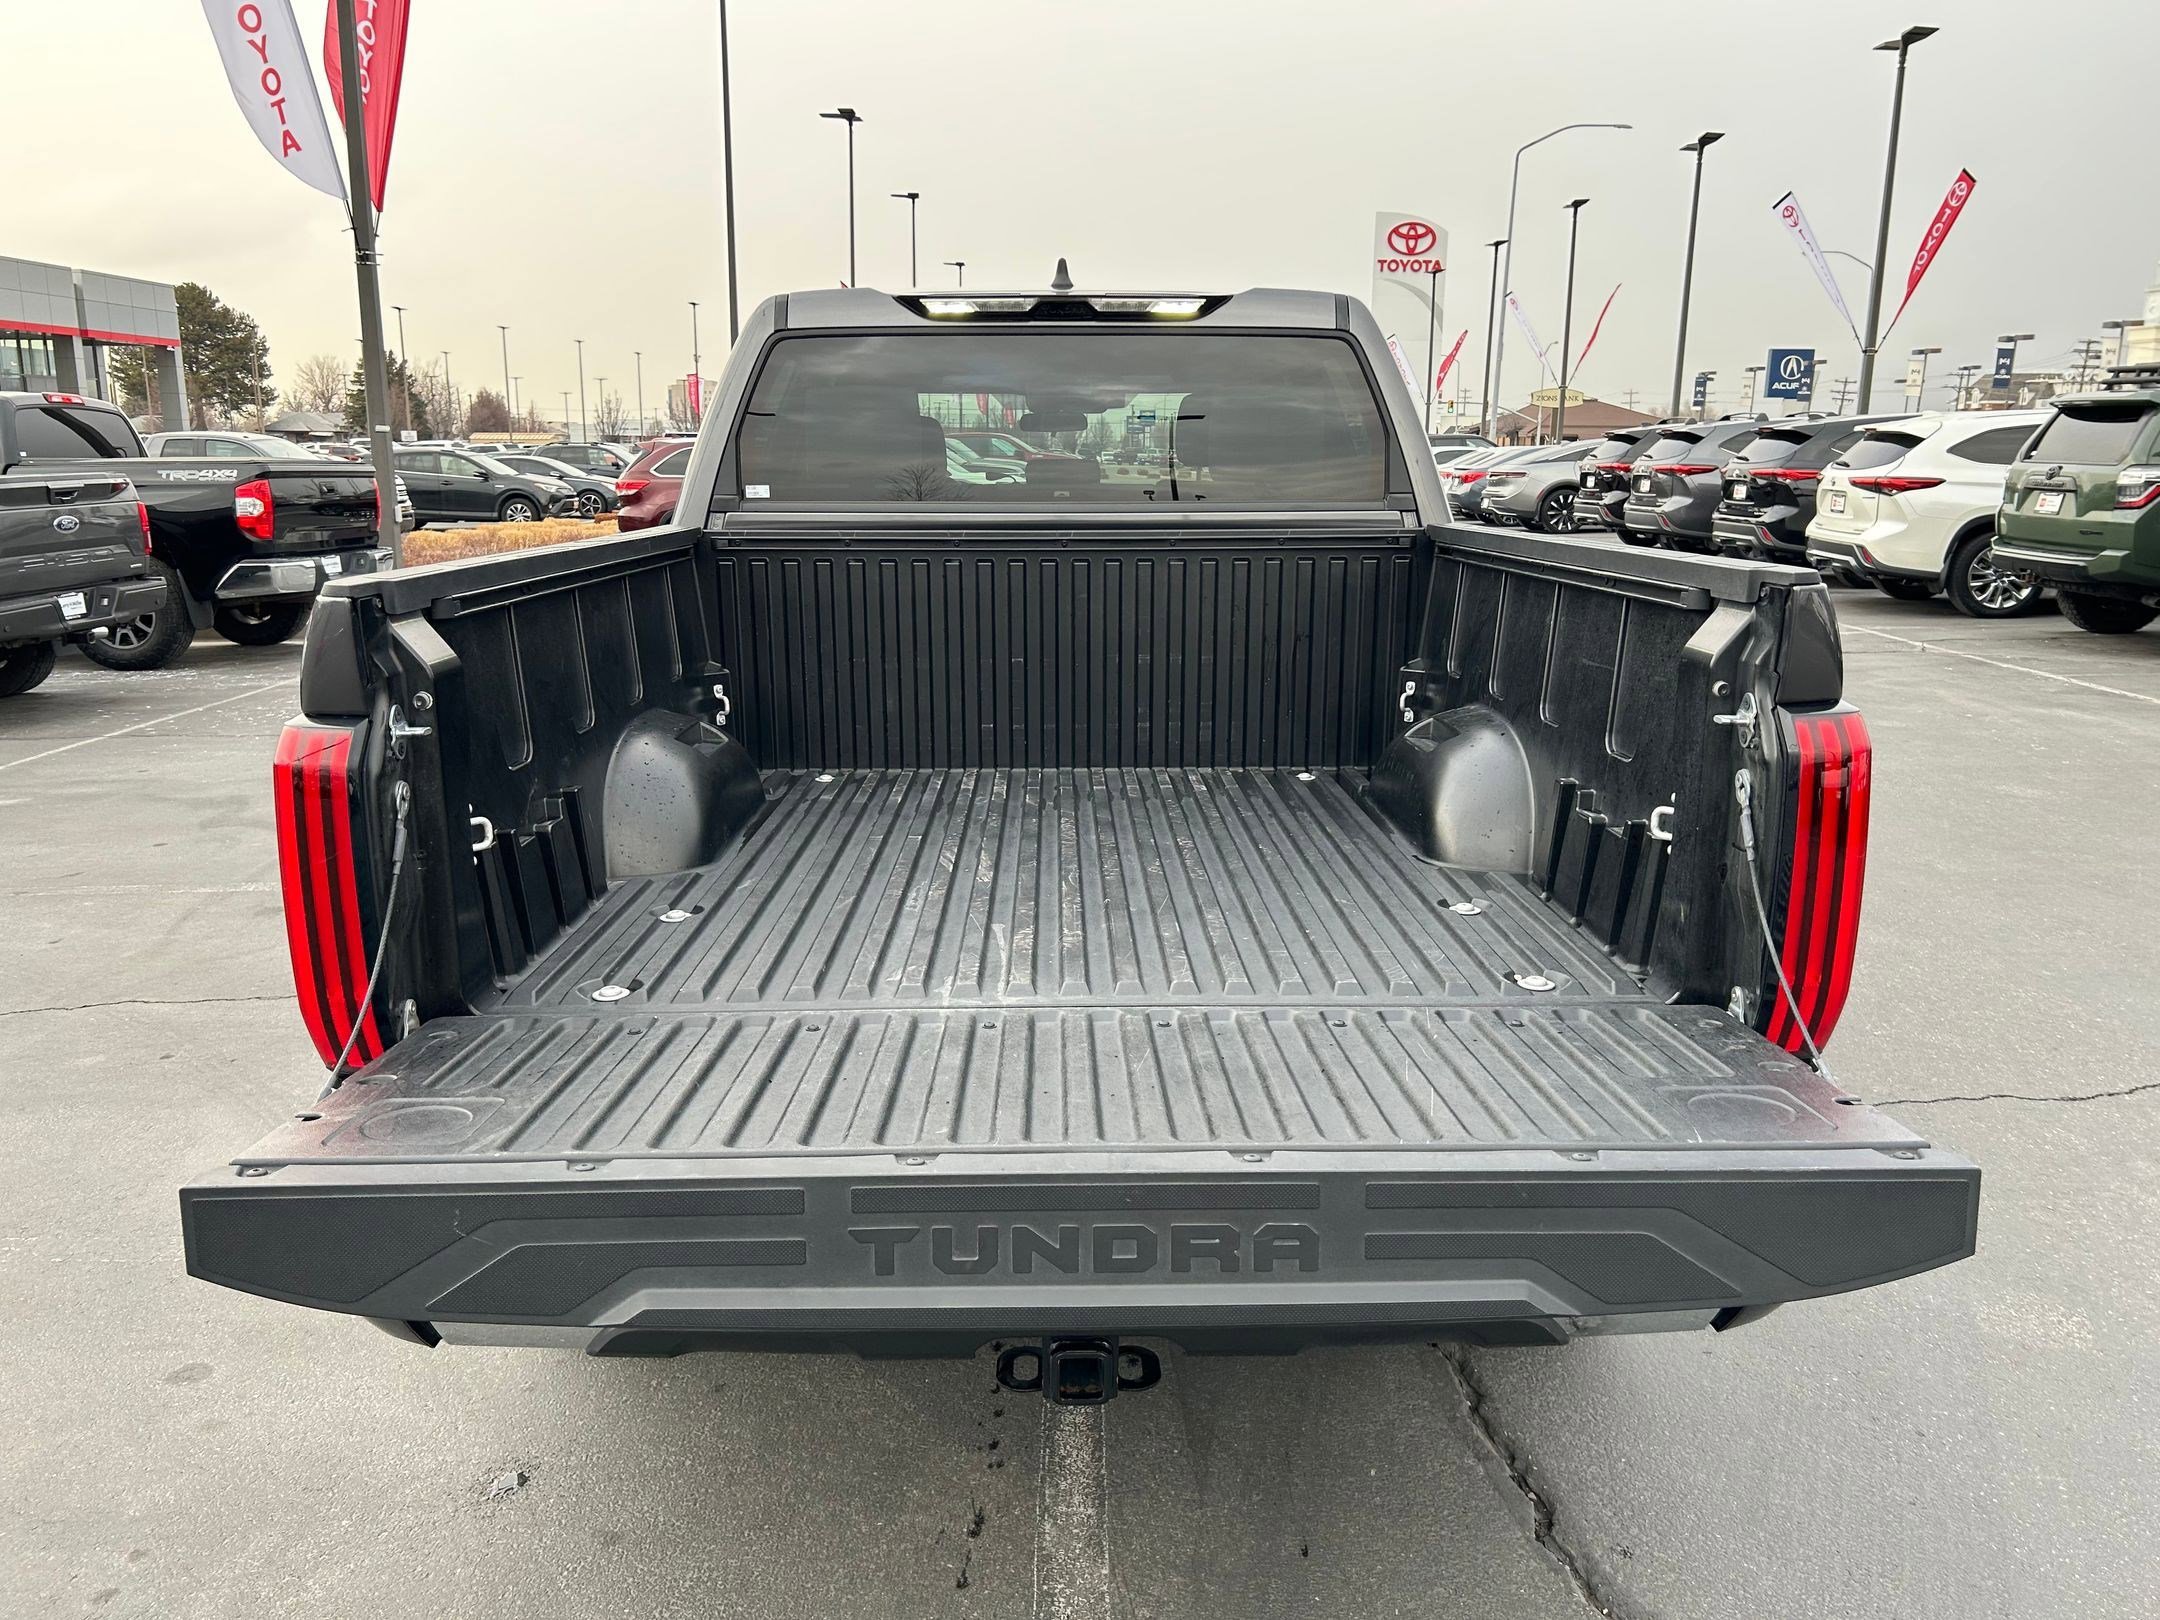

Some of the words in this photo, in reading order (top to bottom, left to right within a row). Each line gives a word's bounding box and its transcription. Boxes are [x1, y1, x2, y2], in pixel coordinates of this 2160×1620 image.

[237, 3, 303, 158] OYOTA
[1377, 259, 1442, 273] TOYOTA
[1771, 381, 1800, 390] ACUR
[847, 1222, 1320, 1277] TUNDRA
